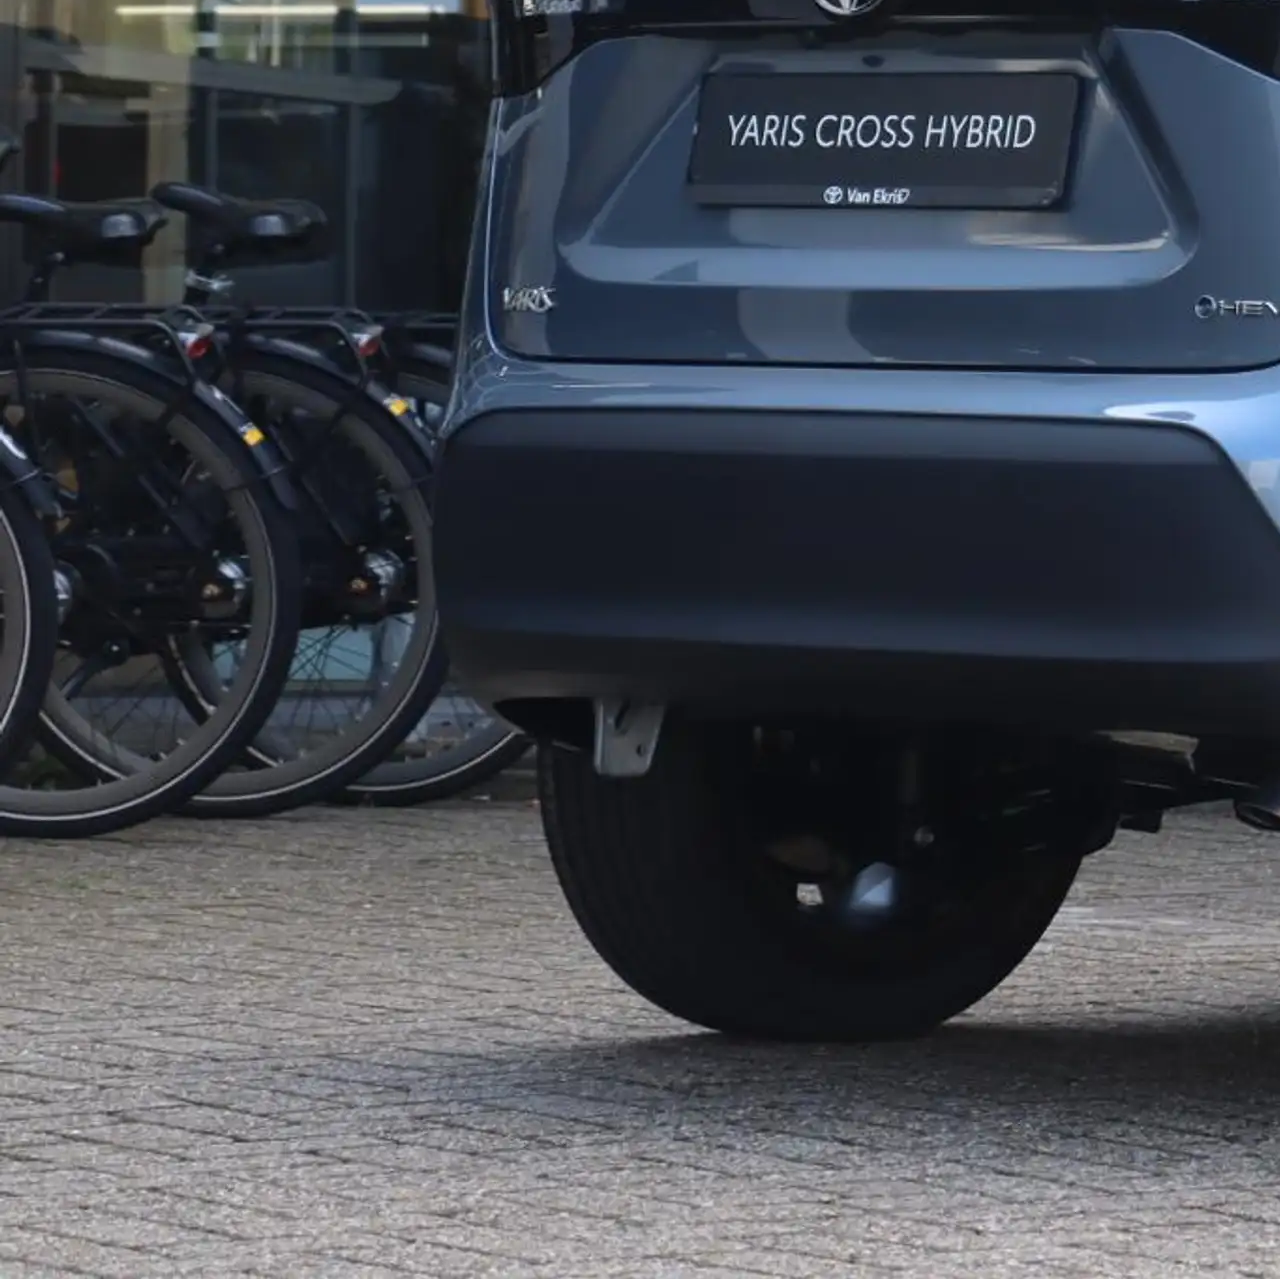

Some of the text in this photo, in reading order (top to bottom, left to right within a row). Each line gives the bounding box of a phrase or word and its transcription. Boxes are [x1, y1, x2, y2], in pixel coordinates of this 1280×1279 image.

[728, 114, 1036, 149] YARIS CROSS HYBRID
[847, 187, 871, 204] Van
